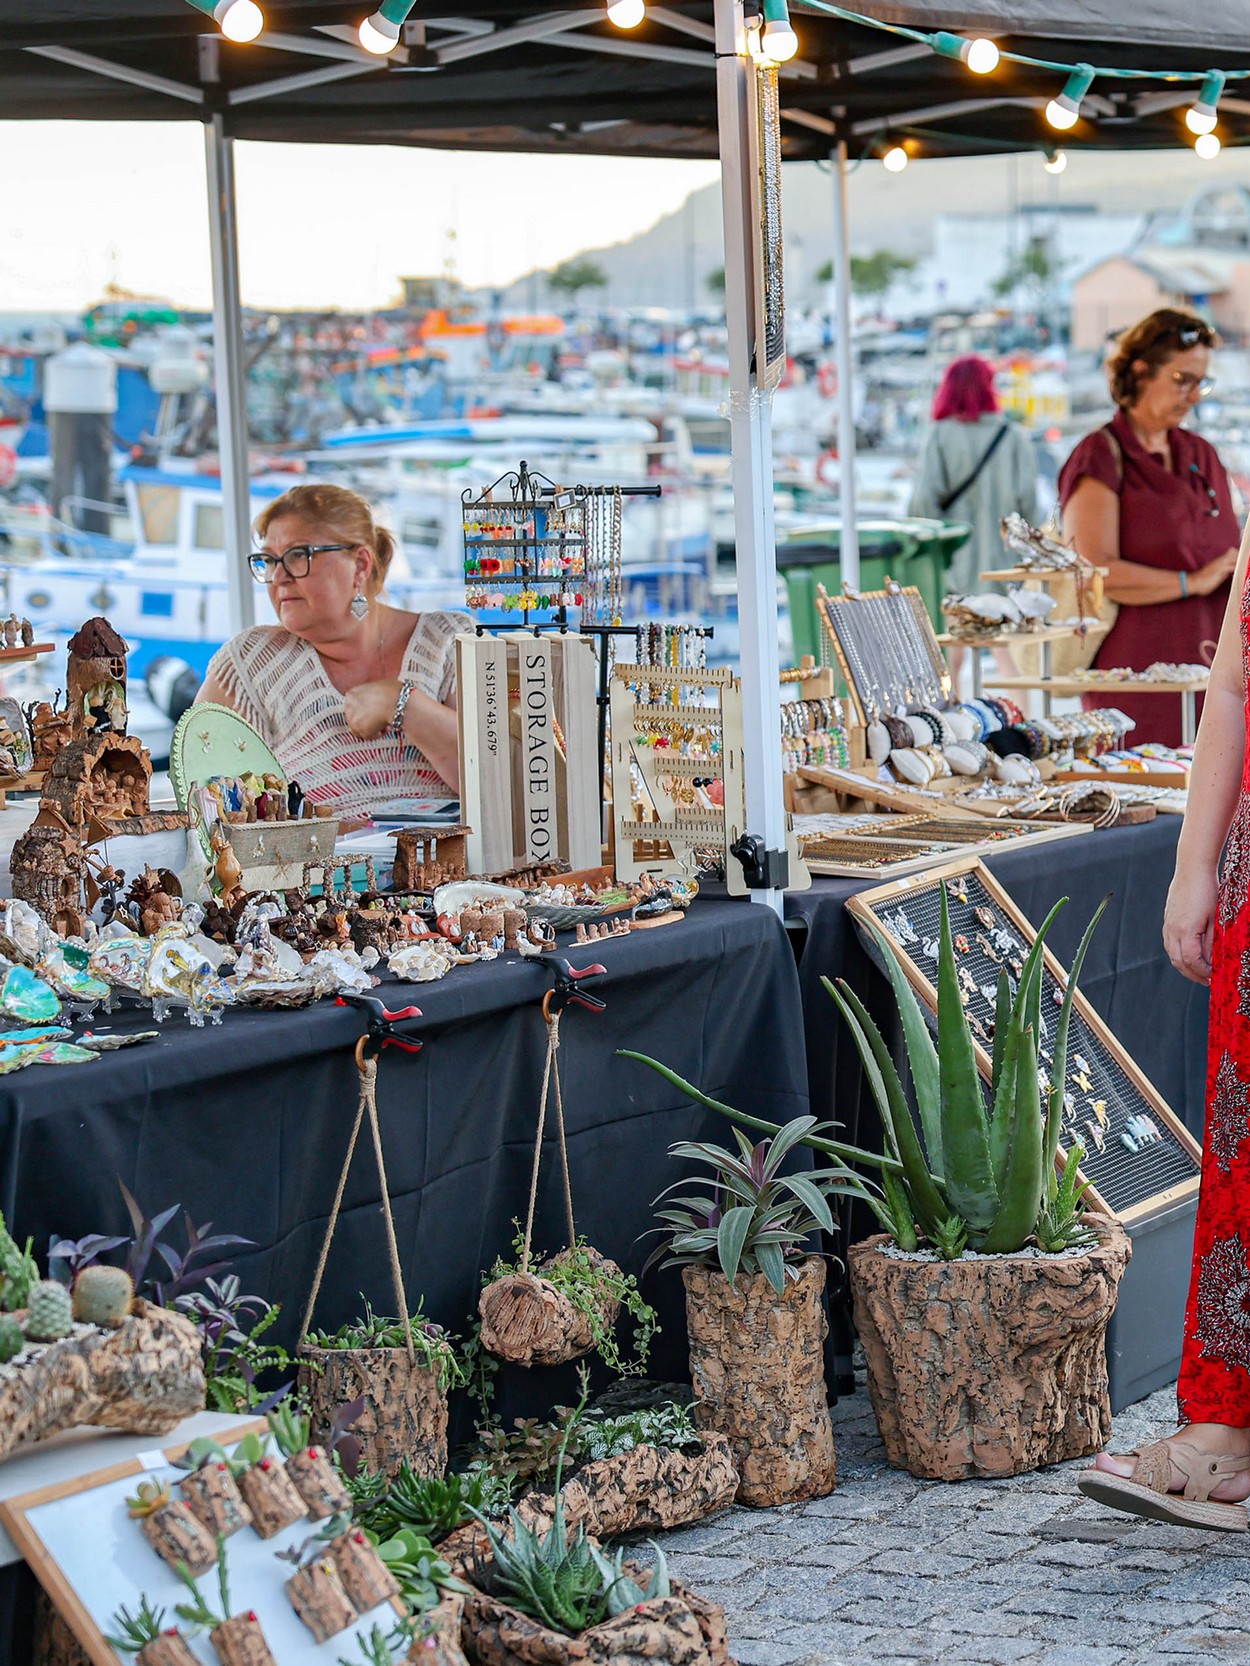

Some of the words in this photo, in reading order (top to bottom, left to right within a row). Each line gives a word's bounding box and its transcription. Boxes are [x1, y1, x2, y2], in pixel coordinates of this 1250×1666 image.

[485, 661, 495, 671] N
[526, 655, 549, 794] STORAGE
[530, 807, 550, 862] BOX
